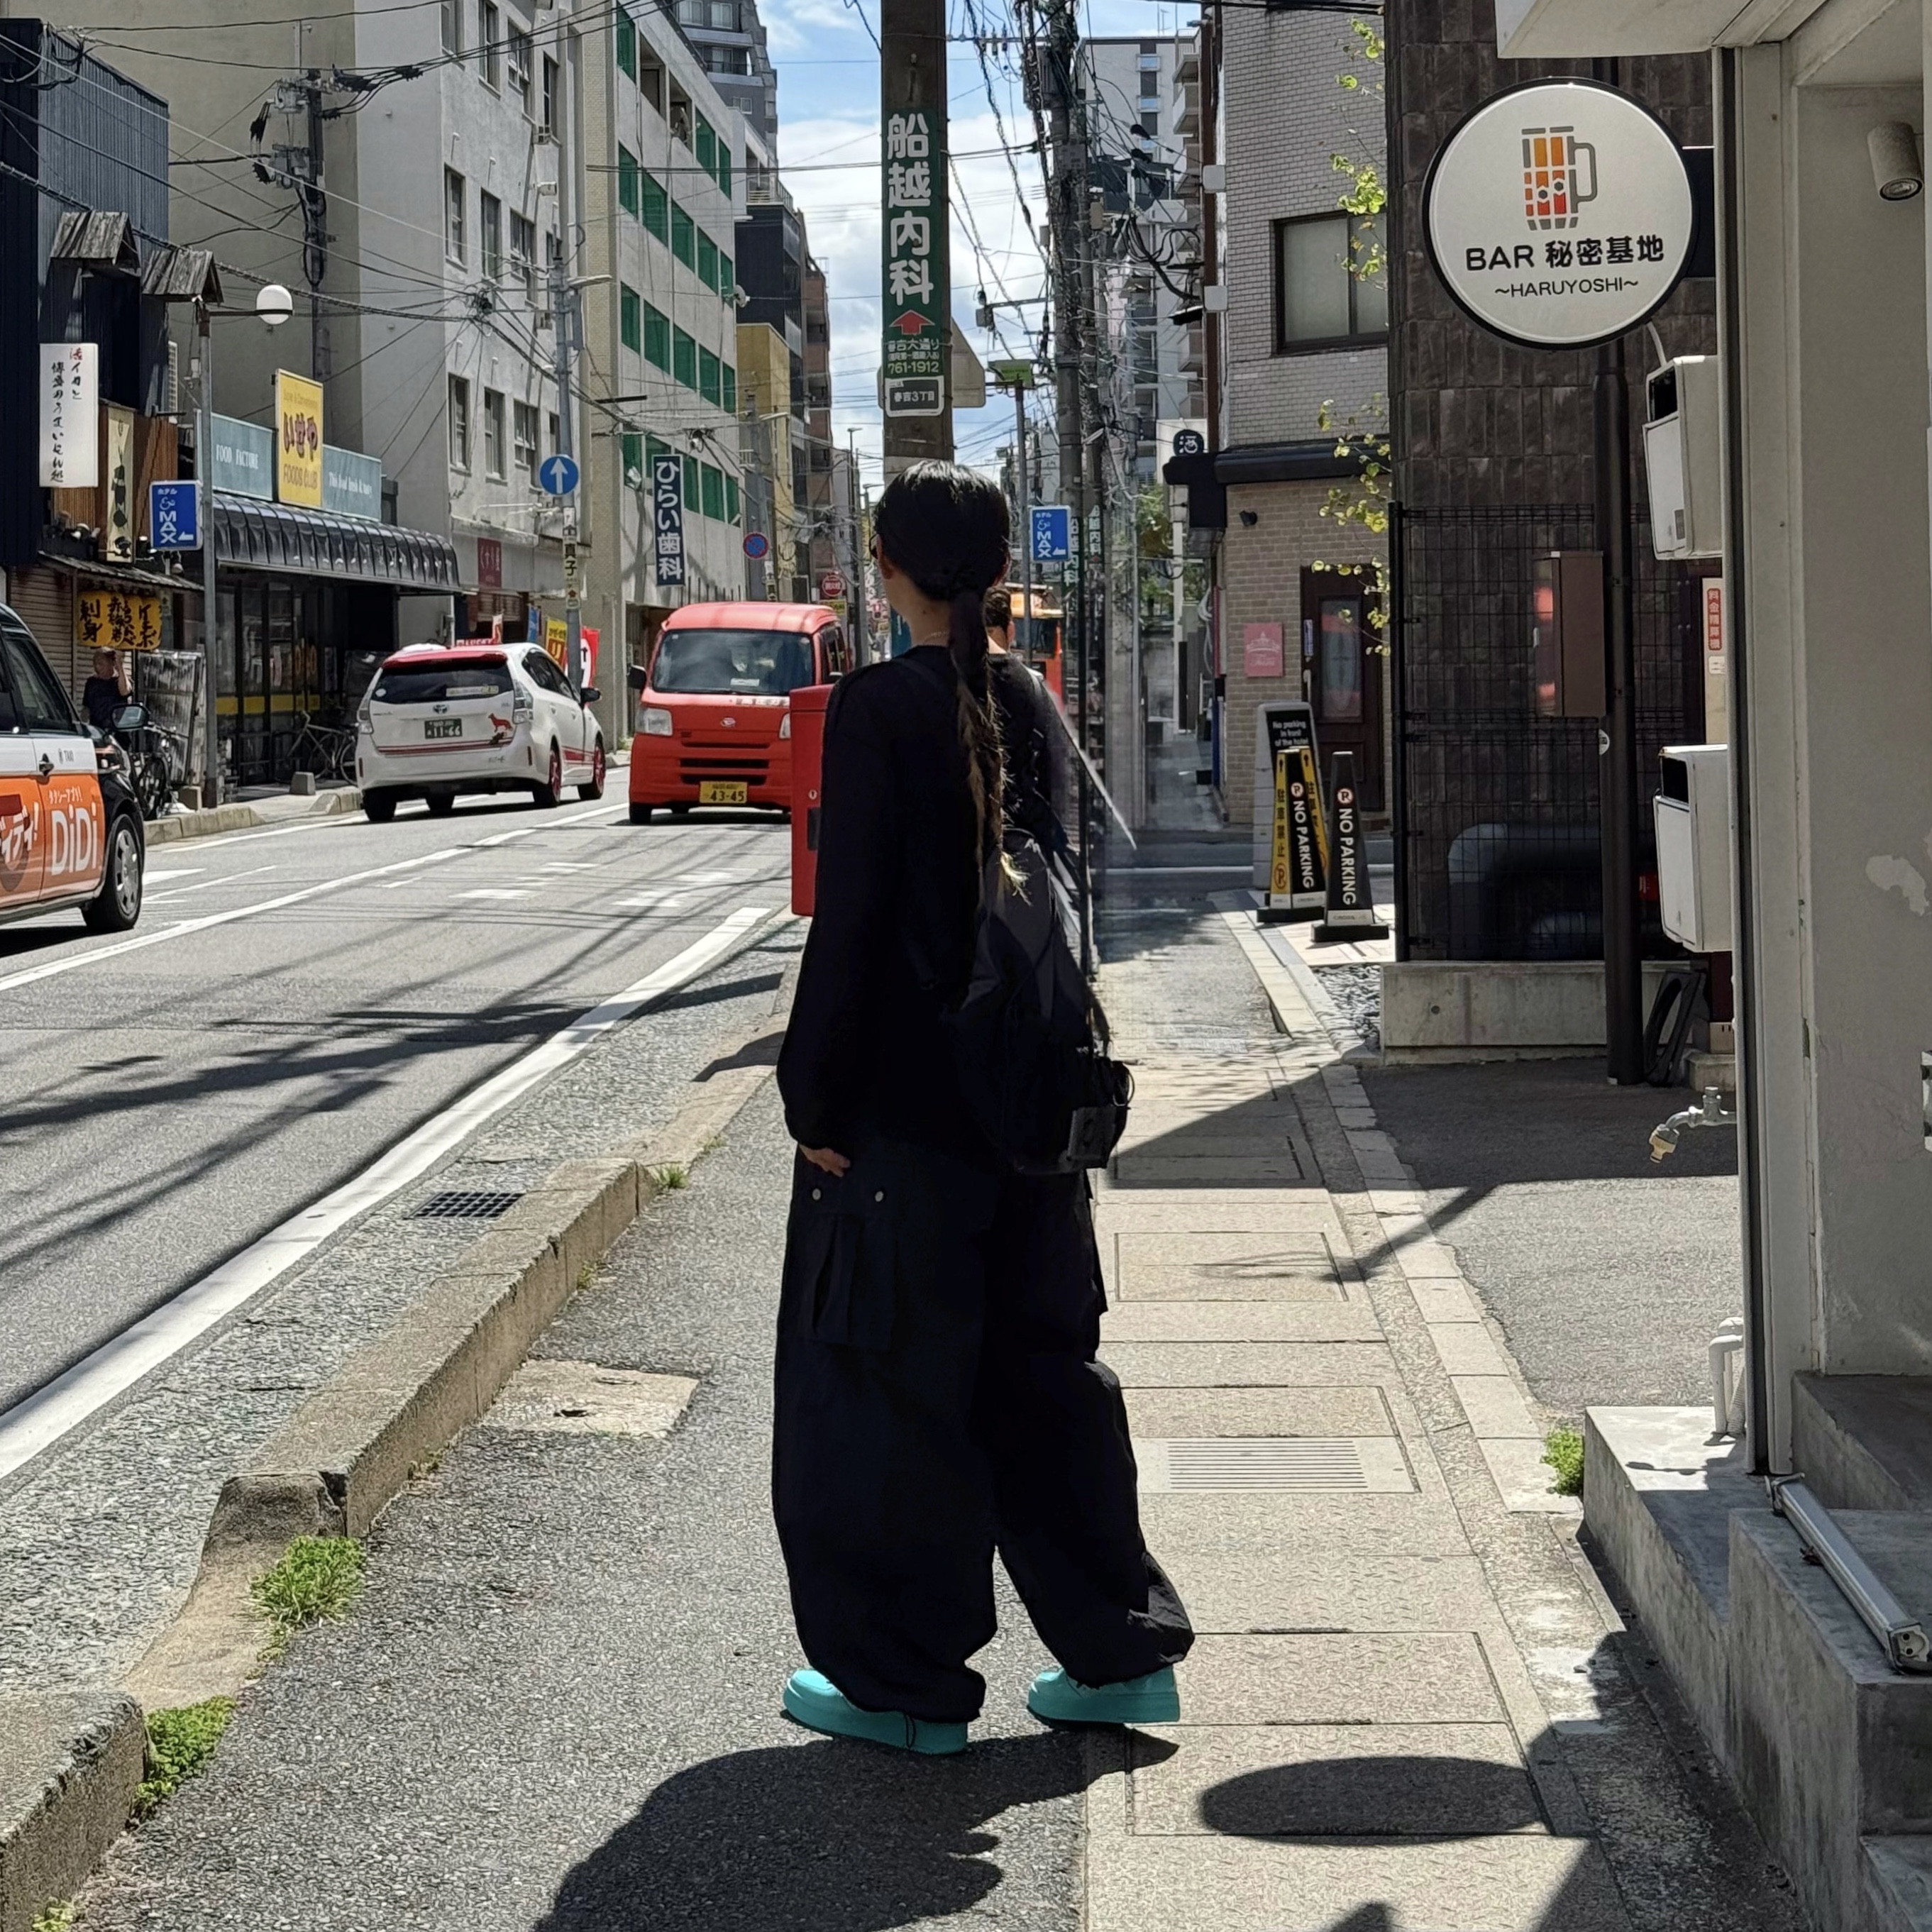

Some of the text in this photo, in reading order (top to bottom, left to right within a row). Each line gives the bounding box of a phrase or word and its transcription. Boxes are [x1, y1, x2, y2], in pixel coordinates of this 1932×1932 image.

[887, 112, 934, 306] 船越内科
[1466, 233, 1665, 271] BAR 秘密基地
[887, 338, 939, 352] 春吉大通り
[887, 361, 939, 375] 761-1912
[894, 390, 935, 402] 春吉3丁目
[216, 444, 232, 464] FOOD
[284, 412, 318, 463] いせや
[159, 510, 177, 543] MAX
[656, 460, 683, 581] ひらい歯科
[1037, 531, 1051, 558] MAX
[80, 599, 103, 643] 刺身
[710, 790, 745, 802] 43-45
[1293, 800, 1307, 823] NO
[1339, 808, 1353, 834] NO
[51, 802, 98, 876] DiDi
[1296, 827, 1314, 889] PARKING
[1340, 837, 1357, 906] PARKING
